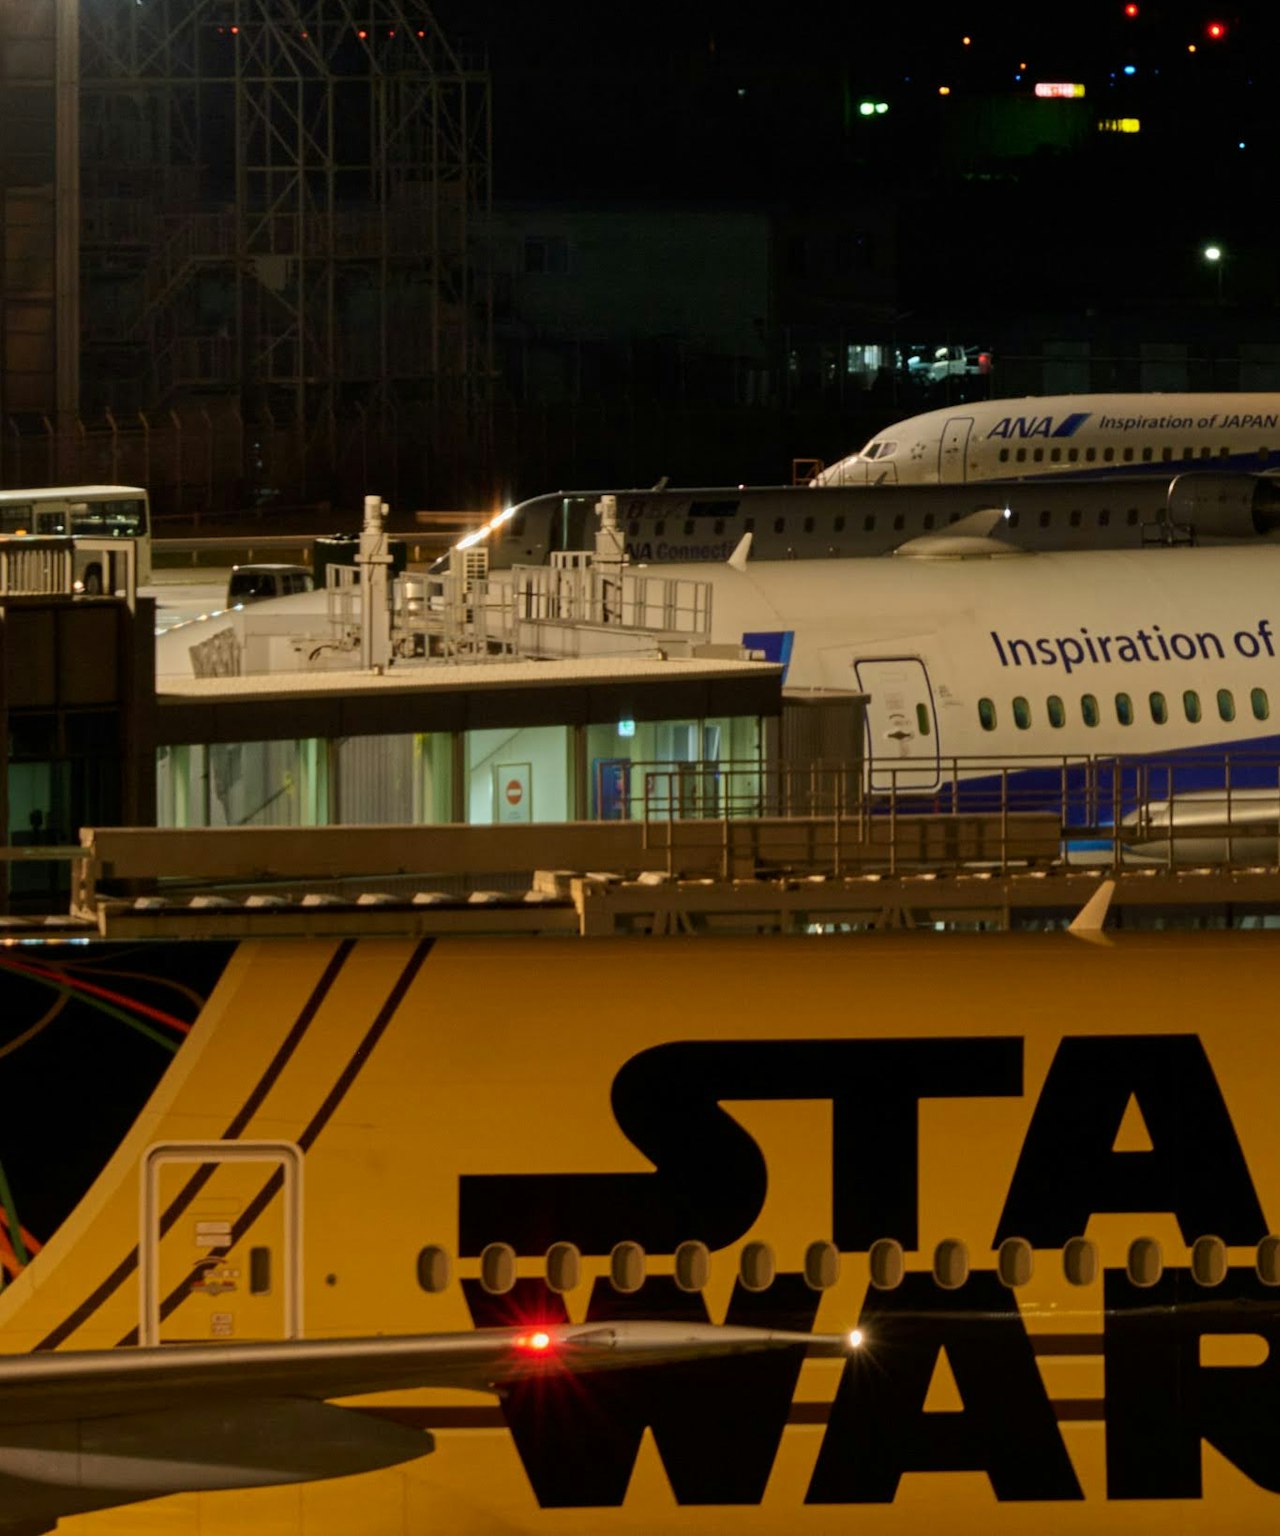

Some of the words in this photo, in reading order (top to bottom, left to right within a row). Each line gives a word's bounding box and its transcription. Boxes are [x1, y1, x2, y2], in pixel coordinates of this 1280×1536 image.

[987, 417, 1052, 438] ANA
[1099, 415, 1195, 431] Inspiration
[1197, 415, 1218, 428] of
[1218, 415, 1278, 428] JAPAN
[990, 625, 1225, 674] Inspiration
[1233, 620, 1275, 657] of
